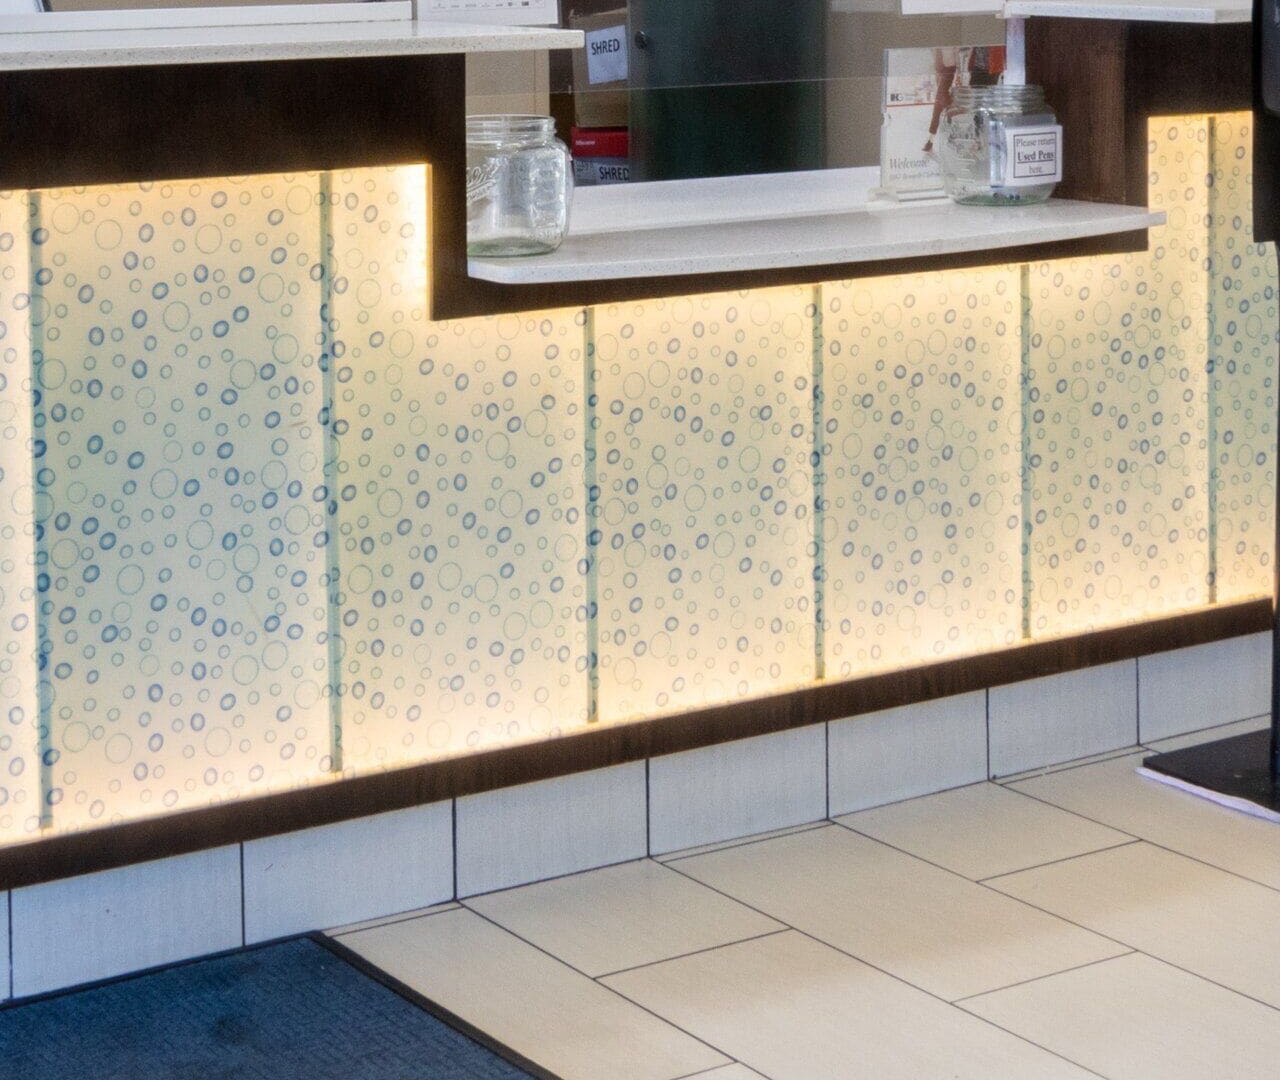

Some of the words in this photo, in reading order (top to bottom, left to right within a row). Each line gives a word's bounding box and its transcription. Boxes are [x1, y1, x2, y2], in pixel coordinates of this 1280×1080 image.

[591, 38, 620, 55] SHRED
[1016, 138, 1037, 147] Please
[1017, 150, 1036, 161] Used
[1038, 149, 1054, 159] Pens
[889, 157, 930, 169] Welcome
[599, 166, 630, 181] SHRED
